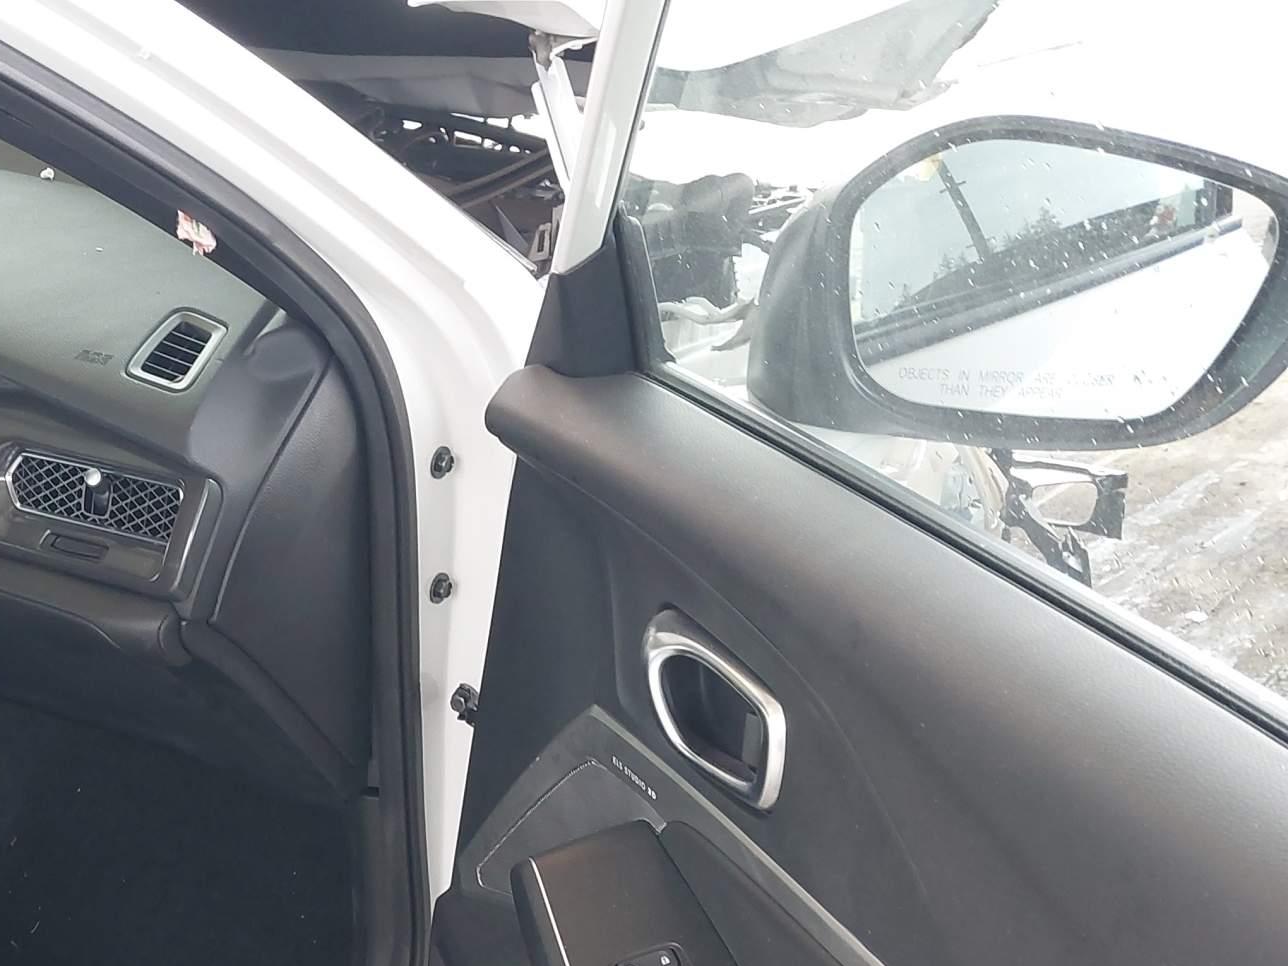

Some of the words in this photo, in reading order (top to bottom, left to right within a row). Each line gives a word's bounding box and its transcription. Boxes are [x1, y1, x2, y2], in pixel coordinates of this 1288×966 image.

[898, 367, 951, 381] OBJECTS
[958, 368, 970, 381] IN
[978, 369, 1024, 384] MIRROR
[940, 383, 969, 396] THAN
[979, 385, 1009, 399] THEY
[624, 766, 646, 790] STUDIO
